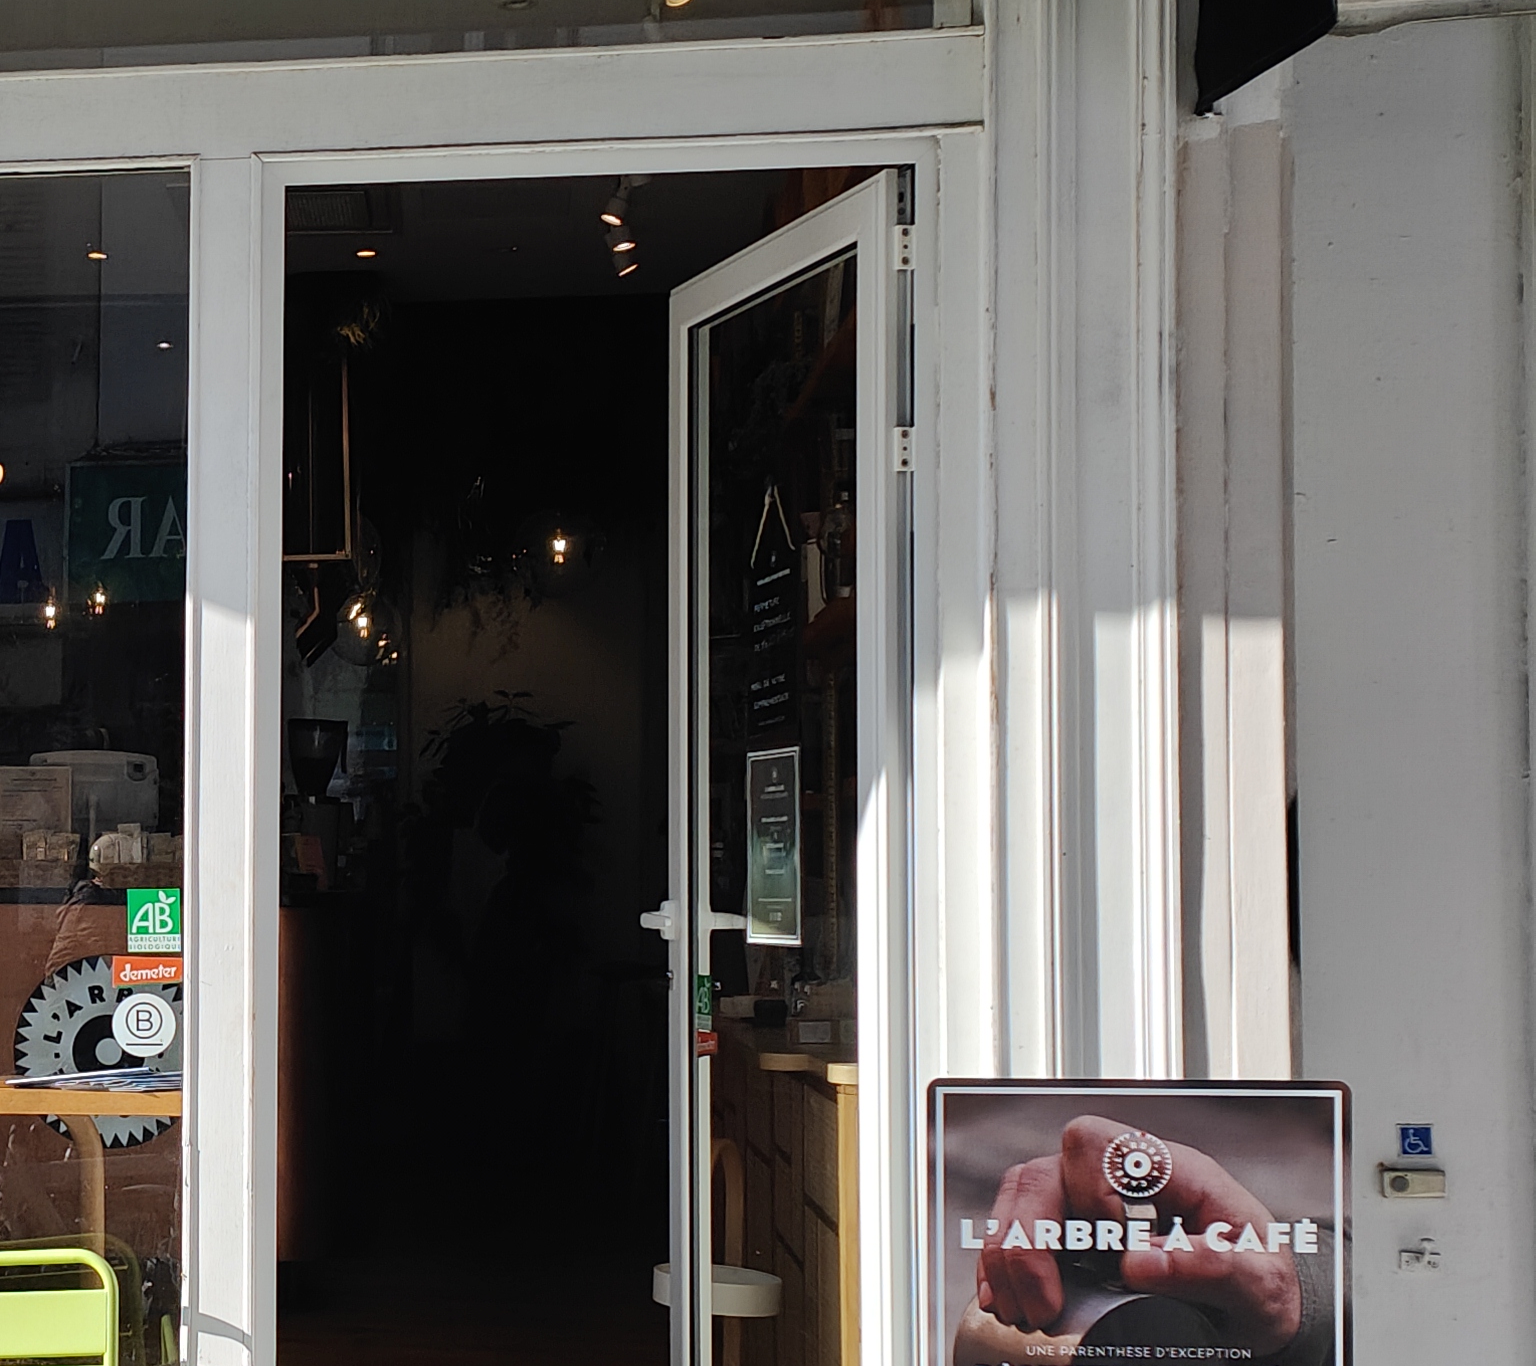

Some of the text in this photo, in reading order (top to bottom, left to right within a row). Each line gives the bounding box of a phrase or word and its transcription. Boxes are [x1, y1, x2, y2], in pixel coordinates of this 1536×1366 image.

[131, 901, 174, 934] AB
[119, 962, 178, 983] demeter
[959, 1216, 1319, 1254] L'ARBRE À CAFÉ
[1025, 1345, 1056, 1357] UNE
